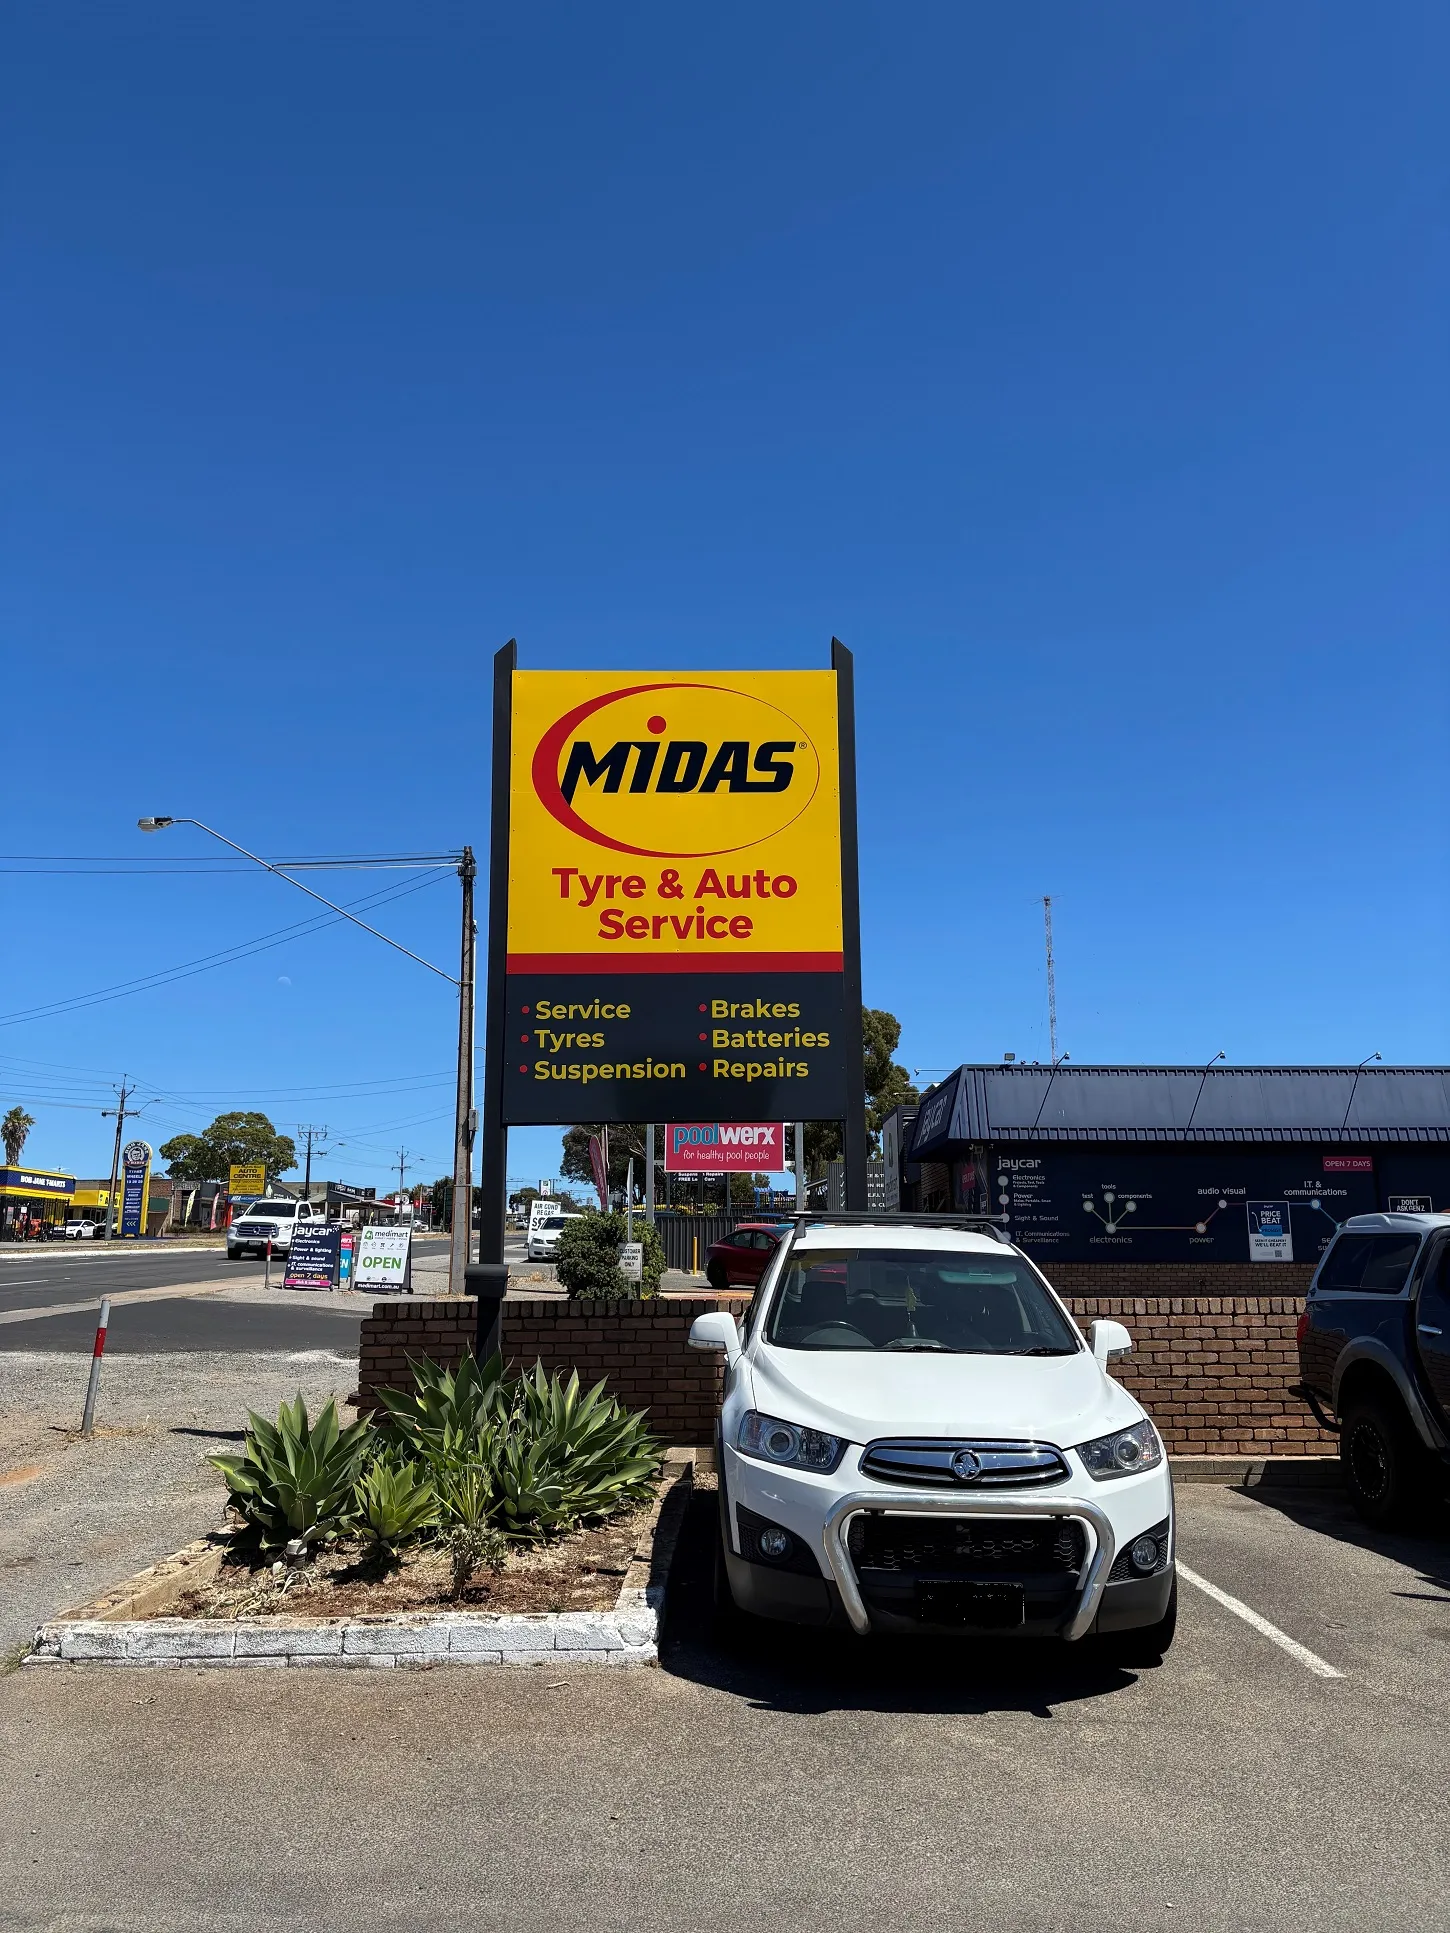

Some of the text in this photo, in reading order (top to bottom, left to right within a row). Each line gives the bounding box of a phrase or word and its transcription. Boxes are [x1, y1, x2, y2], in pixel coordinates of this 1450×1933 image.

[560, 718, 797, 807] MIDAS
[552, 867, 798, 908] Tyre & Auto
[597, 905, 754, 940] Service
[535, 998, 631, 1020] Service
[711, 998, 801, 1019] Brakes
[534, 1029, 605, 1053] Tyres
[712, 1027, 831, 1048] Batteries
[534, 1057, 686, 1084] Suspension
[713, 1056, 810, 1083] Repairs
[673, 1123, 775, 1154] poolwerx
[683, 1150, 770, 1162] for healthy pool people
[997, 1156, 1042, 1171] jaycar
[20, 1175, 33, 1184] BOB
[33, 1177, 45, 1186] JANE
[1197, 1187, 1246, 1195] audio visual
[1283, 1188, 1348, 1196] communications
[544, 1203, 559, 1211] COND
[292, 1224, 333, 1238] jaycar
[374, 1230, 409, 1238] medimart
[1089, 1236, 1133, 1244] electronics
[1188, 1237, 1215, 1245] power
[362, 1256, 402, 1270] OPEN
